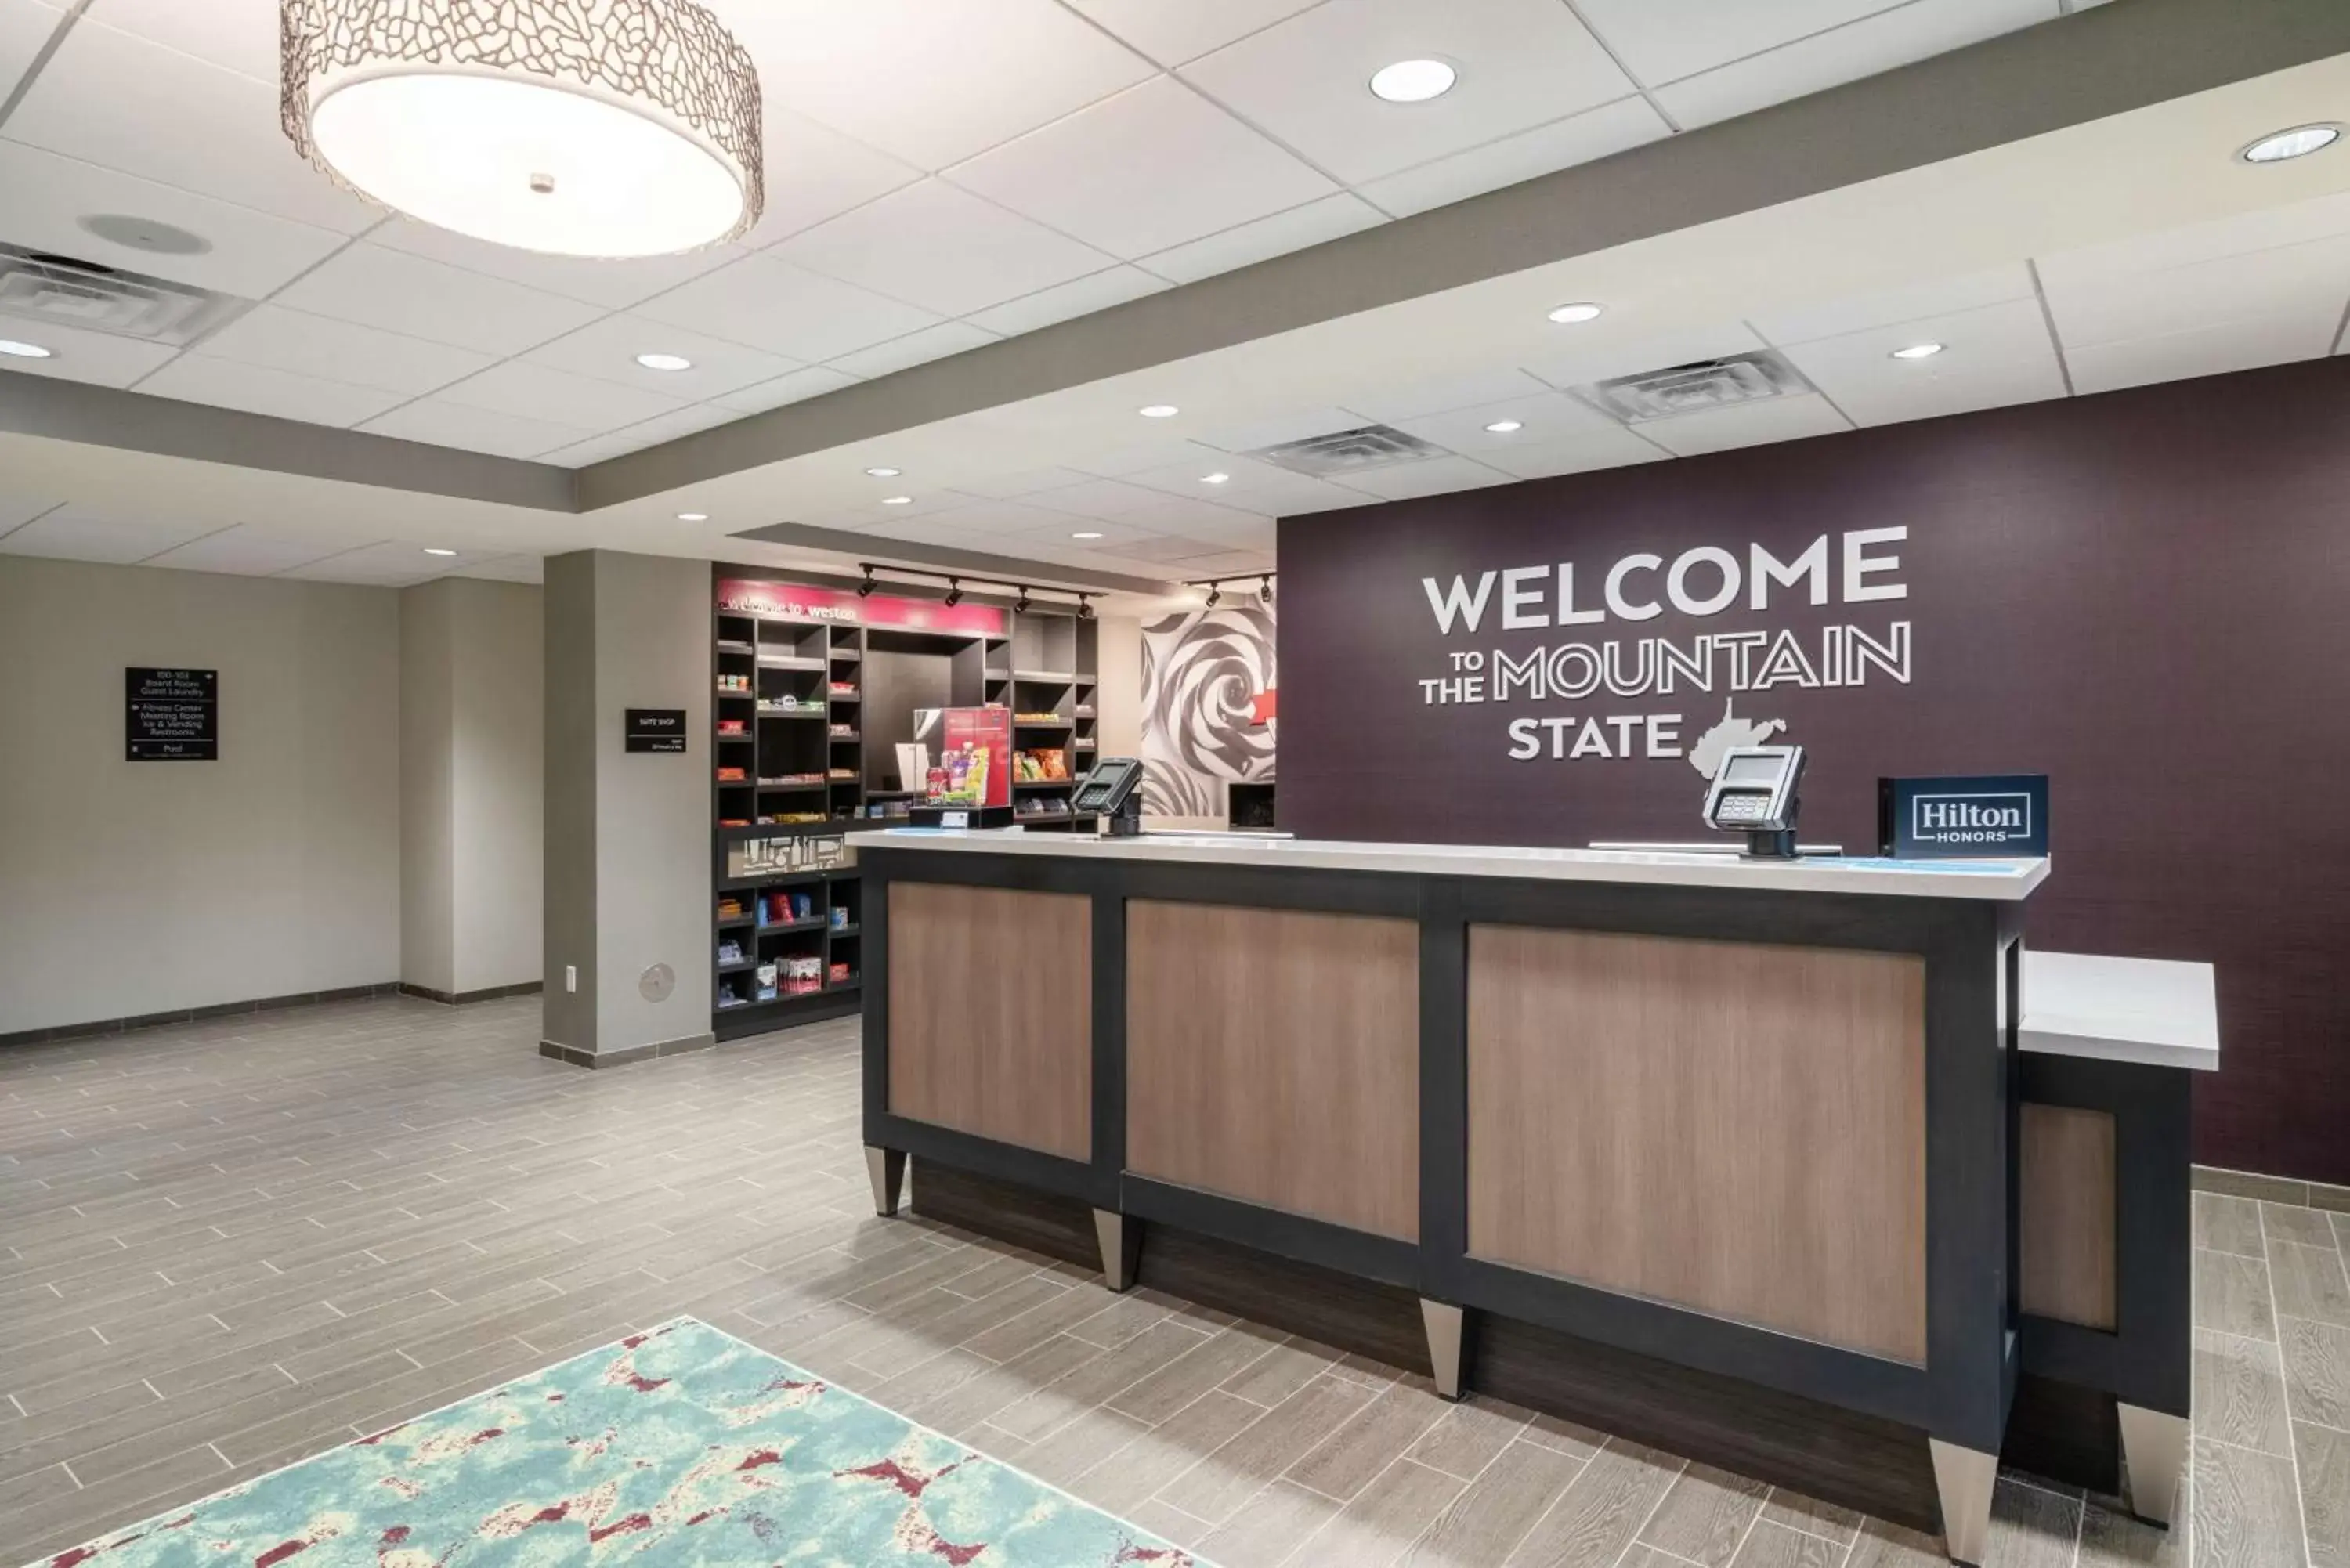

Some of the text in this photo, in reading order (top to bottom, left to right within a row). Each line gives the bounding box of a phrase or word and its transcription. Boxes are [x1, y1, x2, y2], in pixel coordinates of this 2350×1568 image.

[1422, 526, 1907, 635] WELCOME
[1419, 621, 1911, 705] THE MOUNTAIN
[1449, 651, 1485, 672] TO
[168, 688, 204, 697] Laundry
[167, 721, 203, 729] Vending
[1508, 714, 1682, 761] STATE
[1922, 802, 2023, 828] Hilton
[1936, 830, 2007, 843] HONORS
